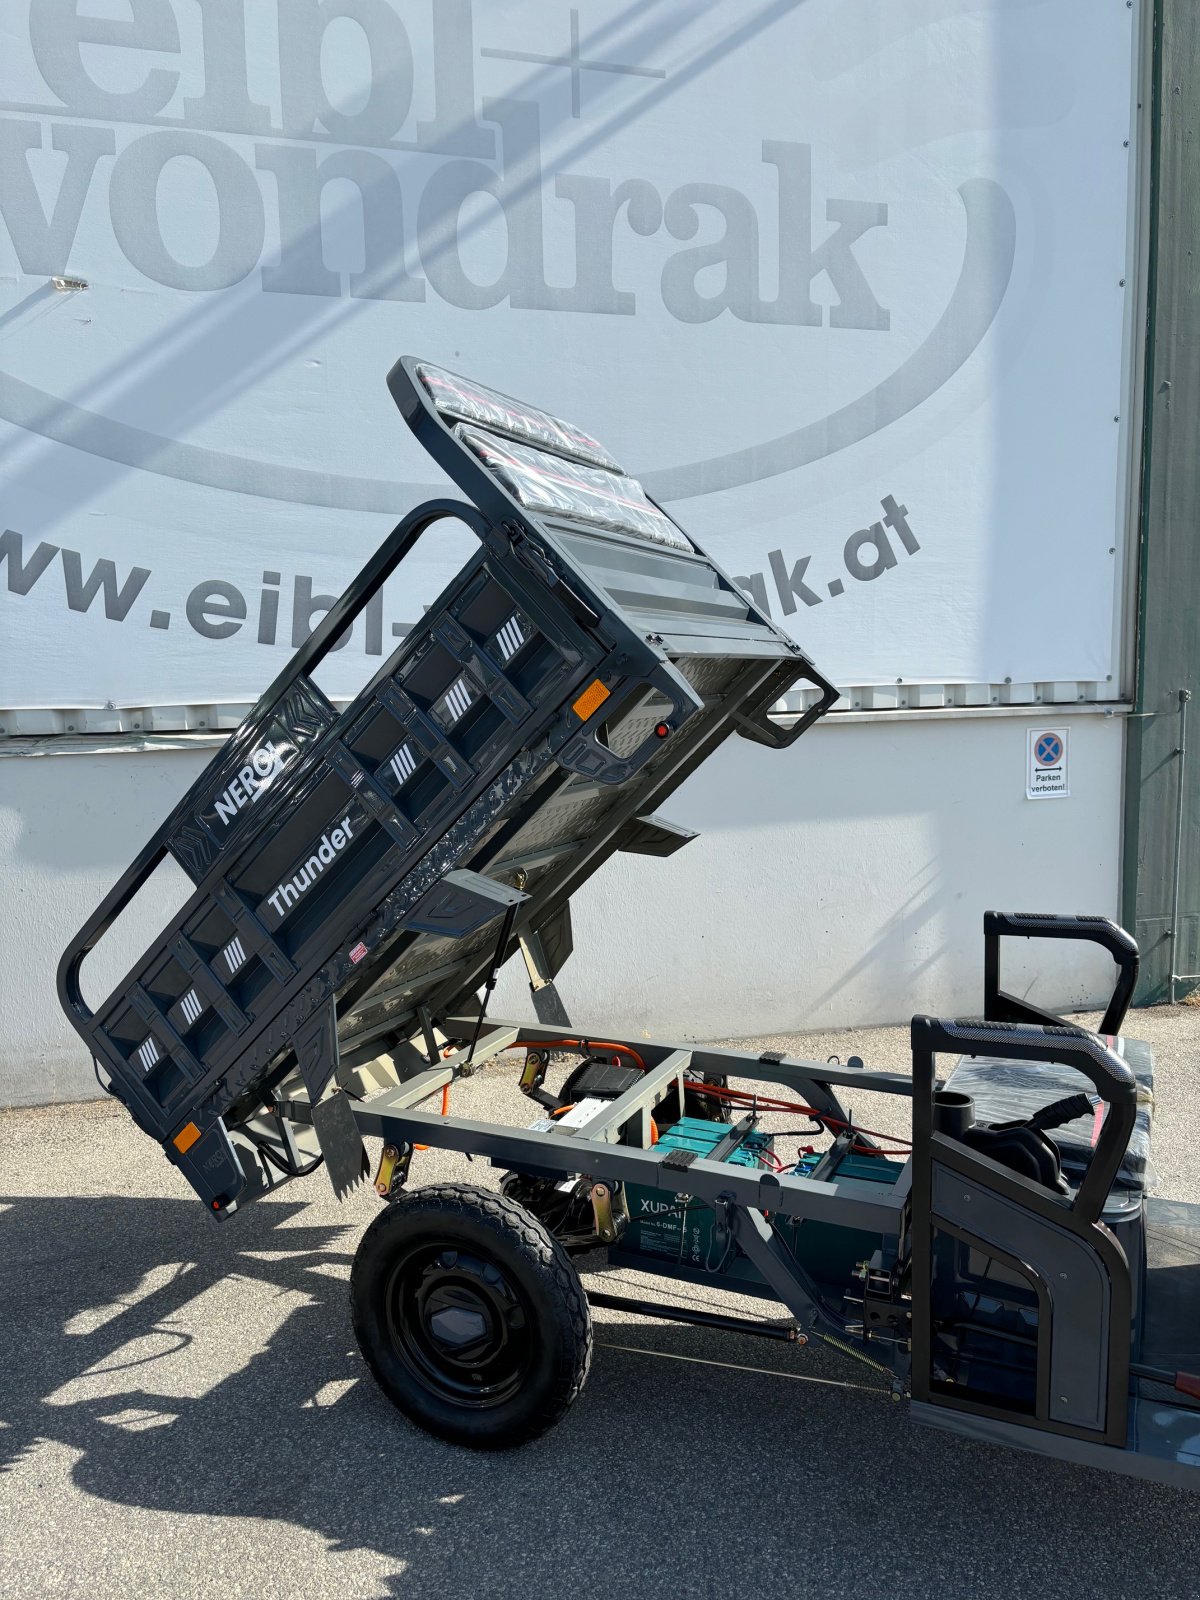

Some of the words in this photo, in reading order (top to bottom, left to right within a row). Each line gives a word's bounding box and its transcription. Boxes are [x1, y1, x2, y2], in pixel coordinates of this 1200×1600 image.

[0, 97, 891, 331] vondrak
[1031, 784, 1065, 792] verboten!
[1036, 774, 1061, 782] Parken
[267, 816, 354, 917] Thunder
[640, 1199, 682, 1219] XUPAI
